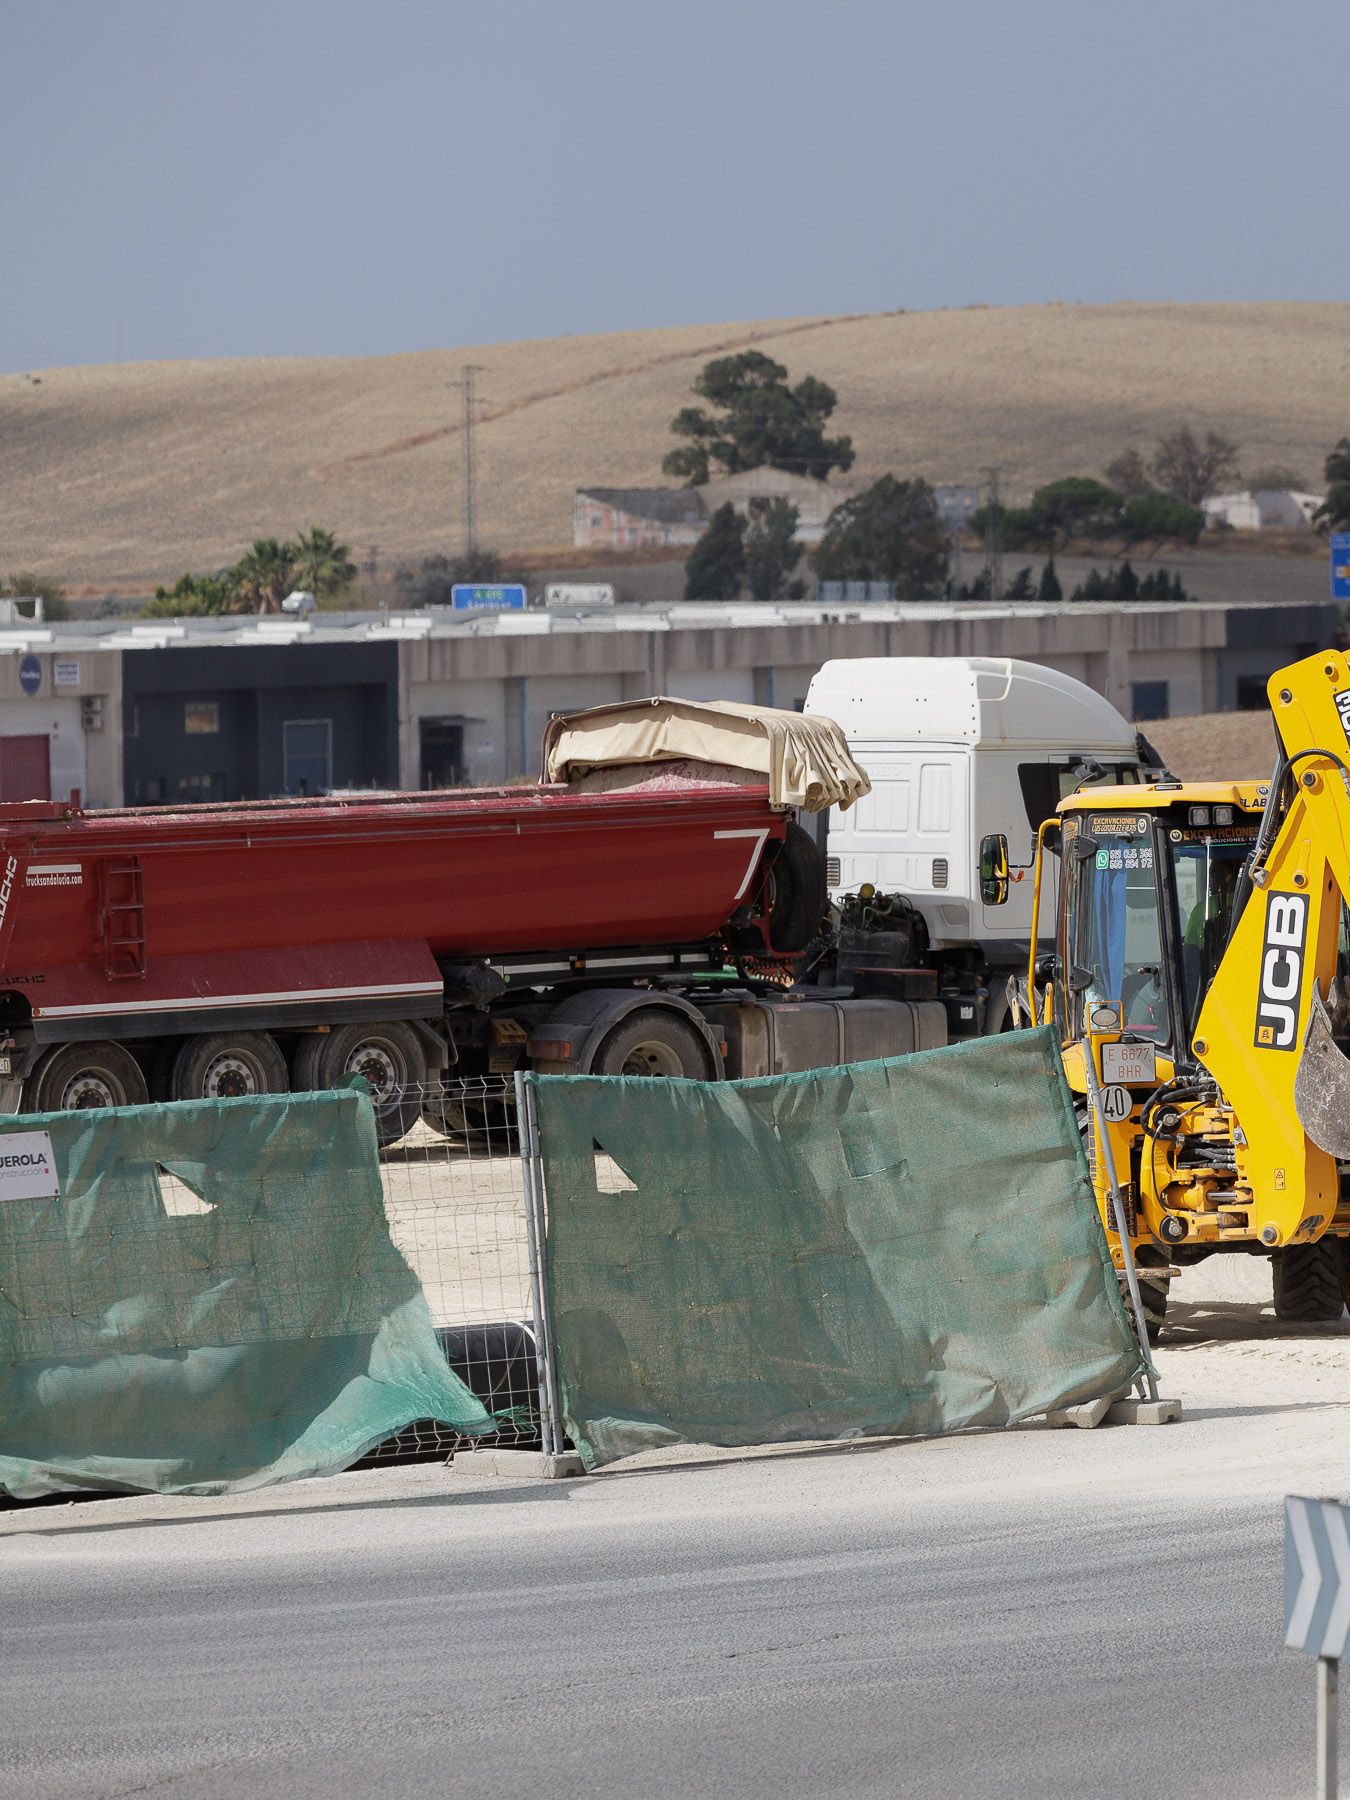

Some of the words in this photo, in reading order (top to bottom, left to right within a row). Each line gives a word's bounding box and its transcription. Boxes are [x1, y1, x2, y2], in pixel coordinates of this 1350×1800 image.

[1093, 817, 1137, 825] EXCAVACIONES
[26, 874, 83, 887] trucksandalucia.com
[1260, 895, 1305, 1046] JCB
[1108, 1048, 1115, 1061] E
[1121, 1047, 1150, 1061] 6677
[1118, 1065, 1142, 1078] BHR
[1104, 1087, 1125, 1117] 40
